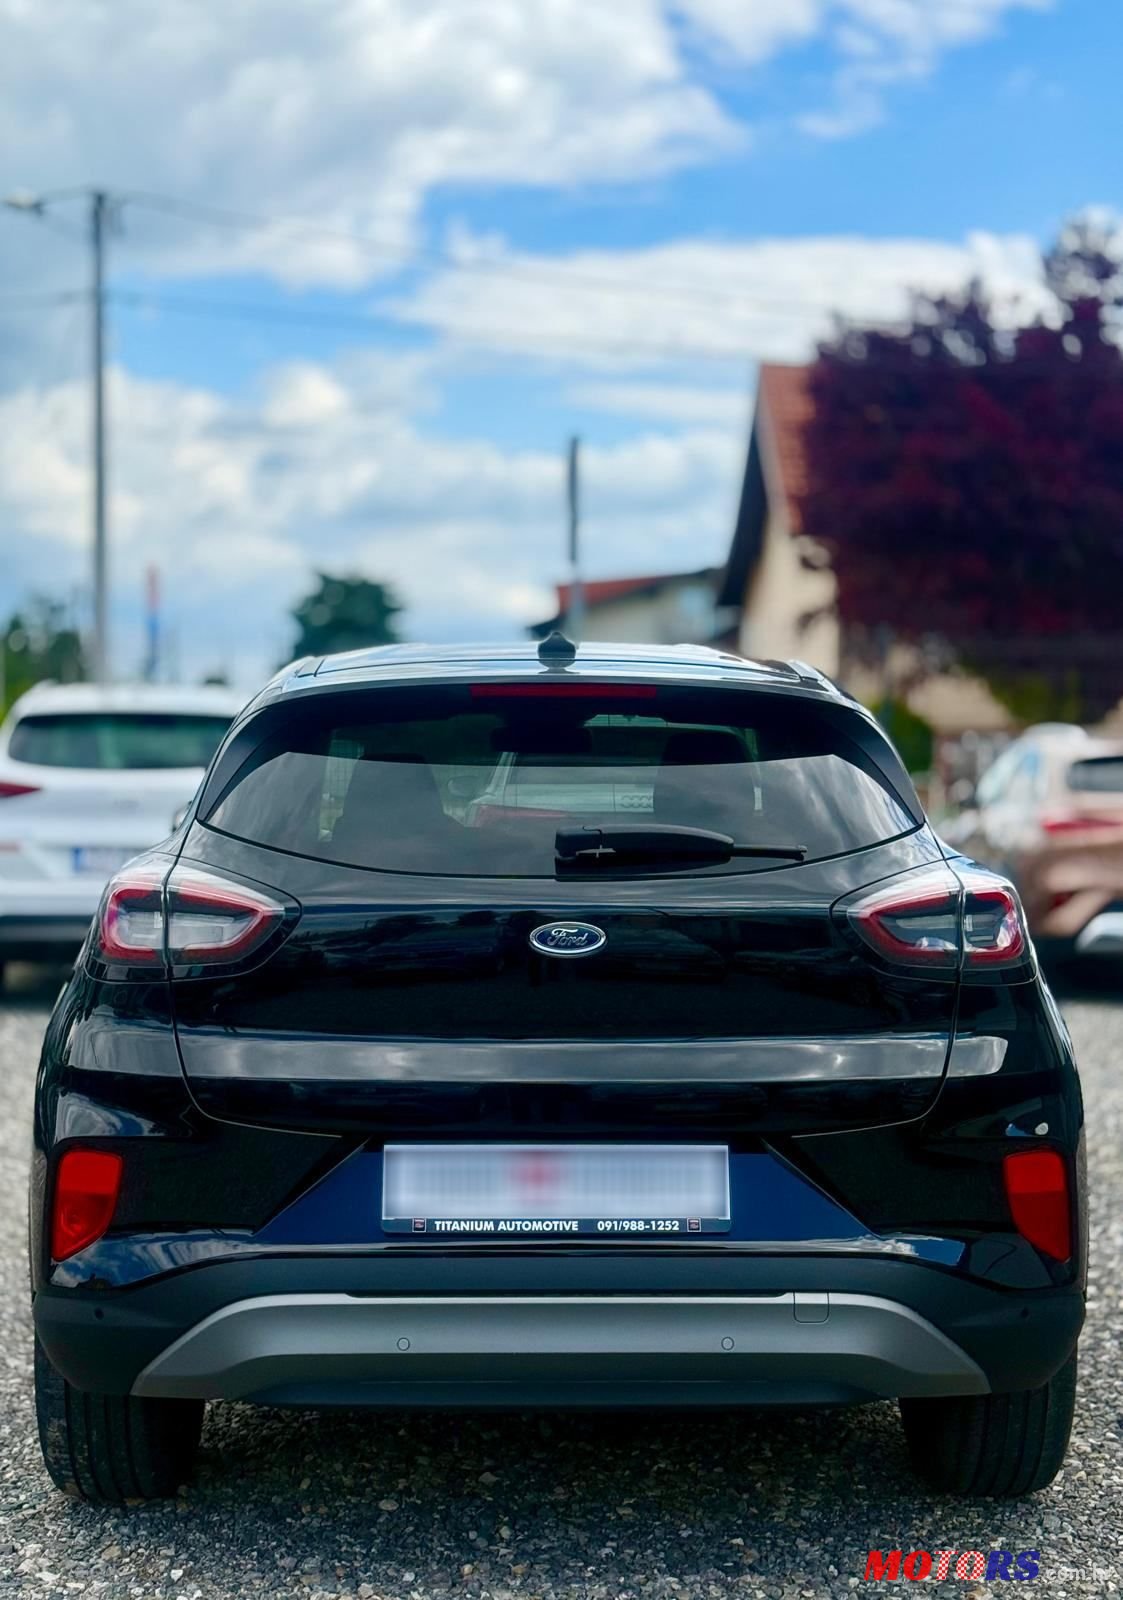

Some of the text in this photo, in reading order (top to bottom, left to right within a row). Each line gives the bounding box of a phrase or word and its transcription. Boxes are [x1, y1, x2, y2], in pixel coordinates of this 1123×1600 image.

[547, 928, 588, 946] Ford
[434, 1219, 680, 1231] TITANIUM AUTOMOTIVE 091/988-1252
